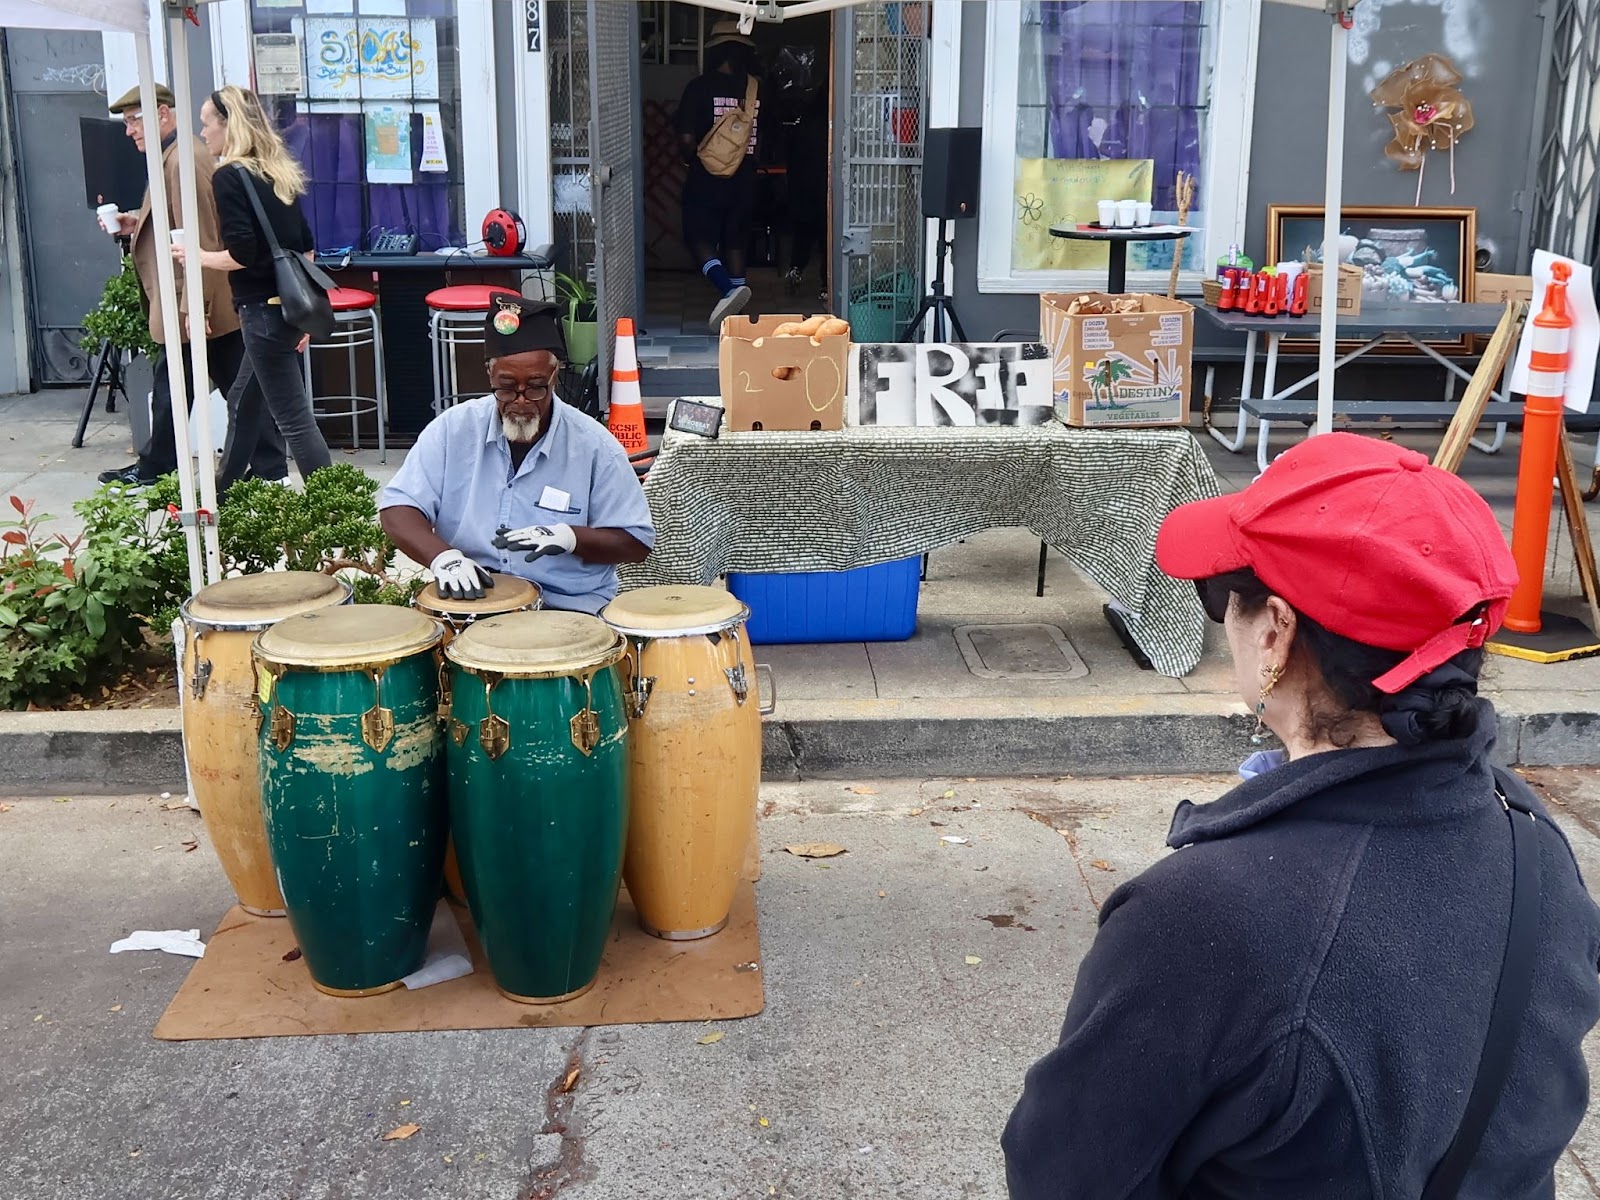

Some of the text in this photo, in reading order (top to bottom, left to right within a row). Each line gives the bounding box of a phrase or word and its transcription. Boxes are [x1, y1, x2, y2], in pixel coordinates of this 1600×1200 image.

[526, 0, 540, 50] 87
[738, 370, 764, 393] 2
[859, 343, 1051, 427] FREE
[1119, 385, 1176, 399] DESTINY
[1107, 411, 1160, 420] VEGETABLES
[609, 423, 639, 432] CCSF
